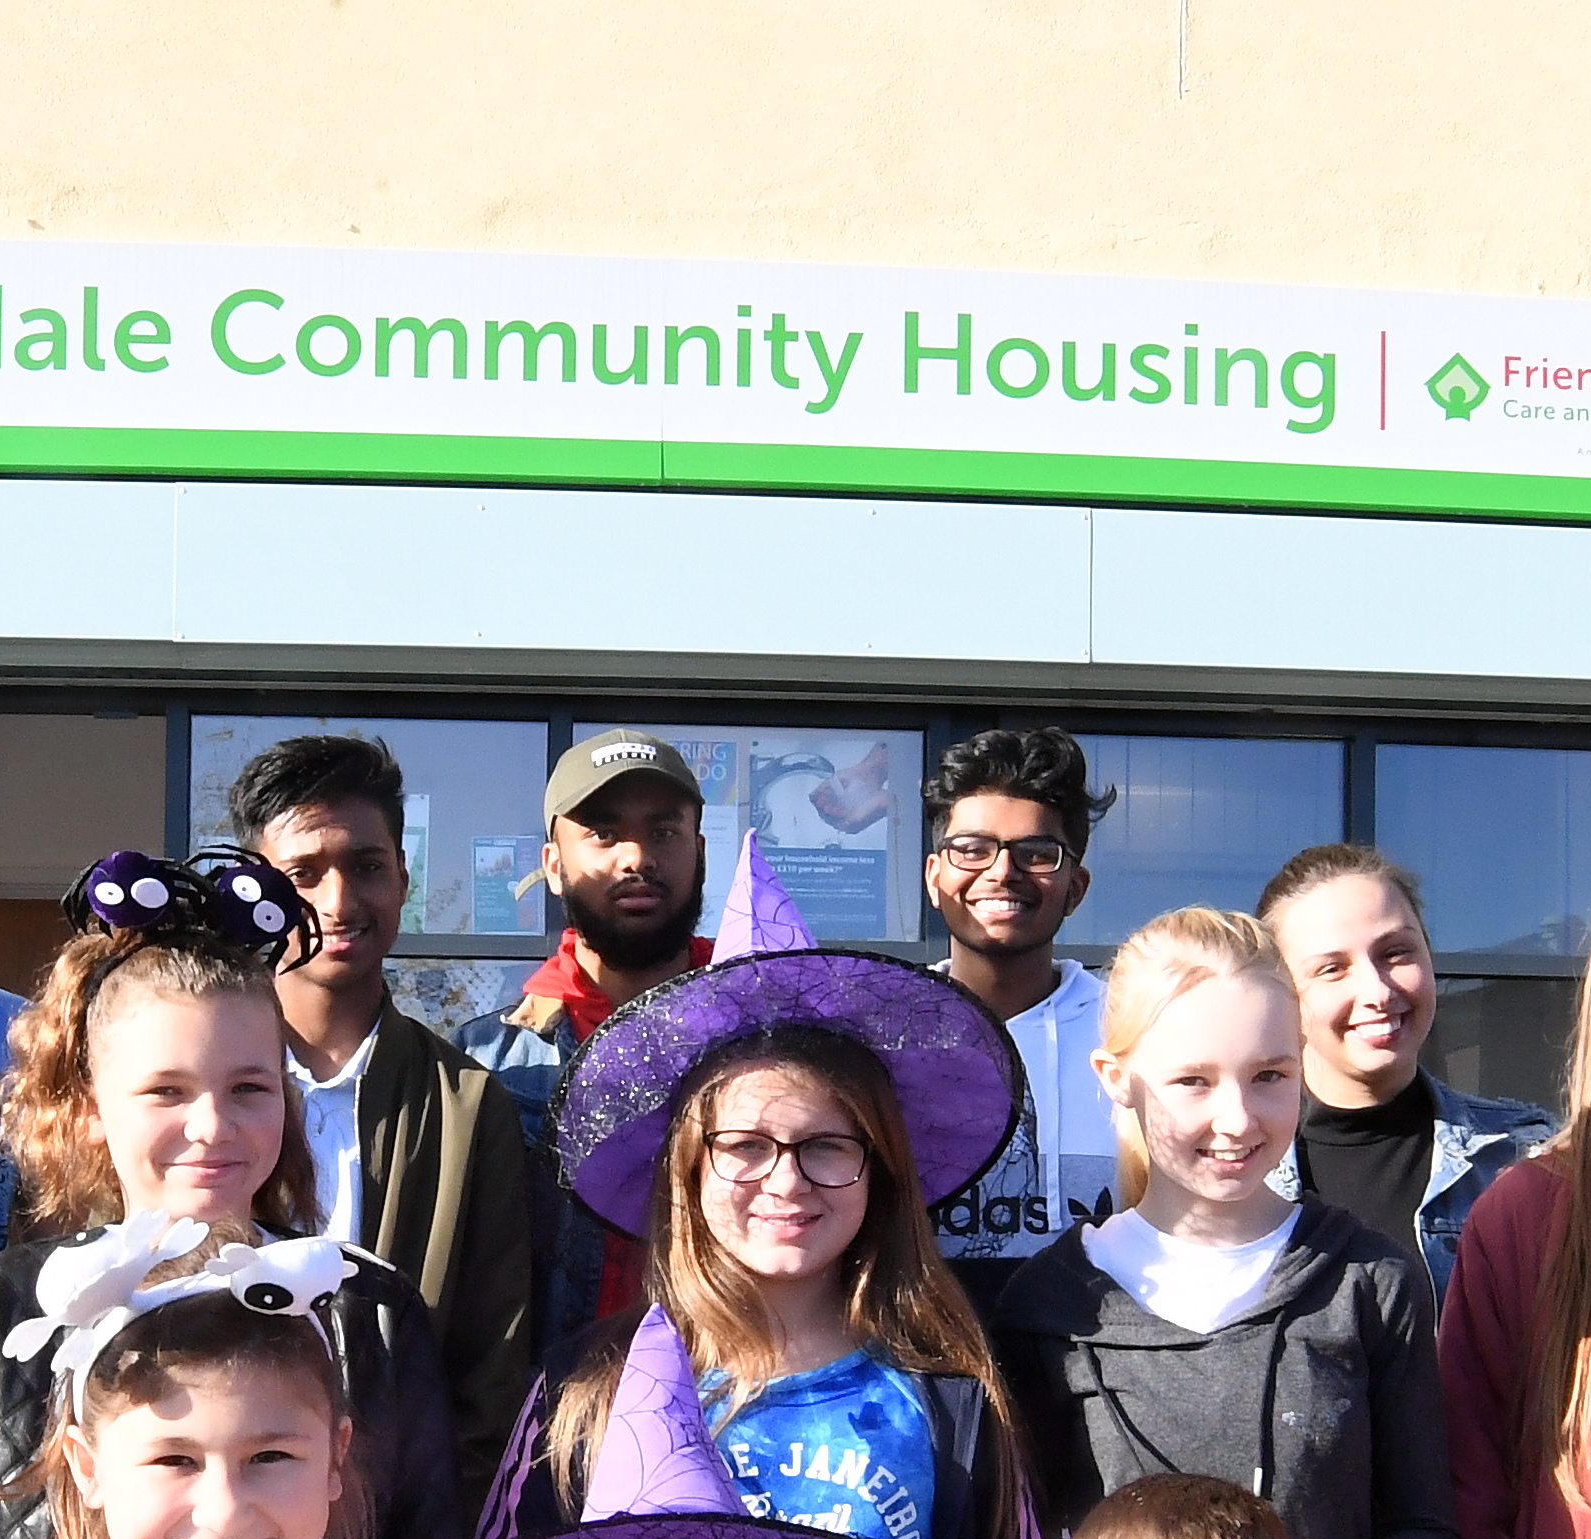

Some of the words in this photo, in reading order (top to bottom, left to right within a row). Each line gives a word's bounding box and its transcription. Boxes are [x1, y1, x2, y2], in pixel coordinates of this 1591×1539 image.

[210, 288, 865, 414] Community
[902, 310, 1338, 434] Housing
[1502, 399, 1556, 420] Care
[1577, 447, 1584, 455] A
[679, 743, 728, 762] RING
